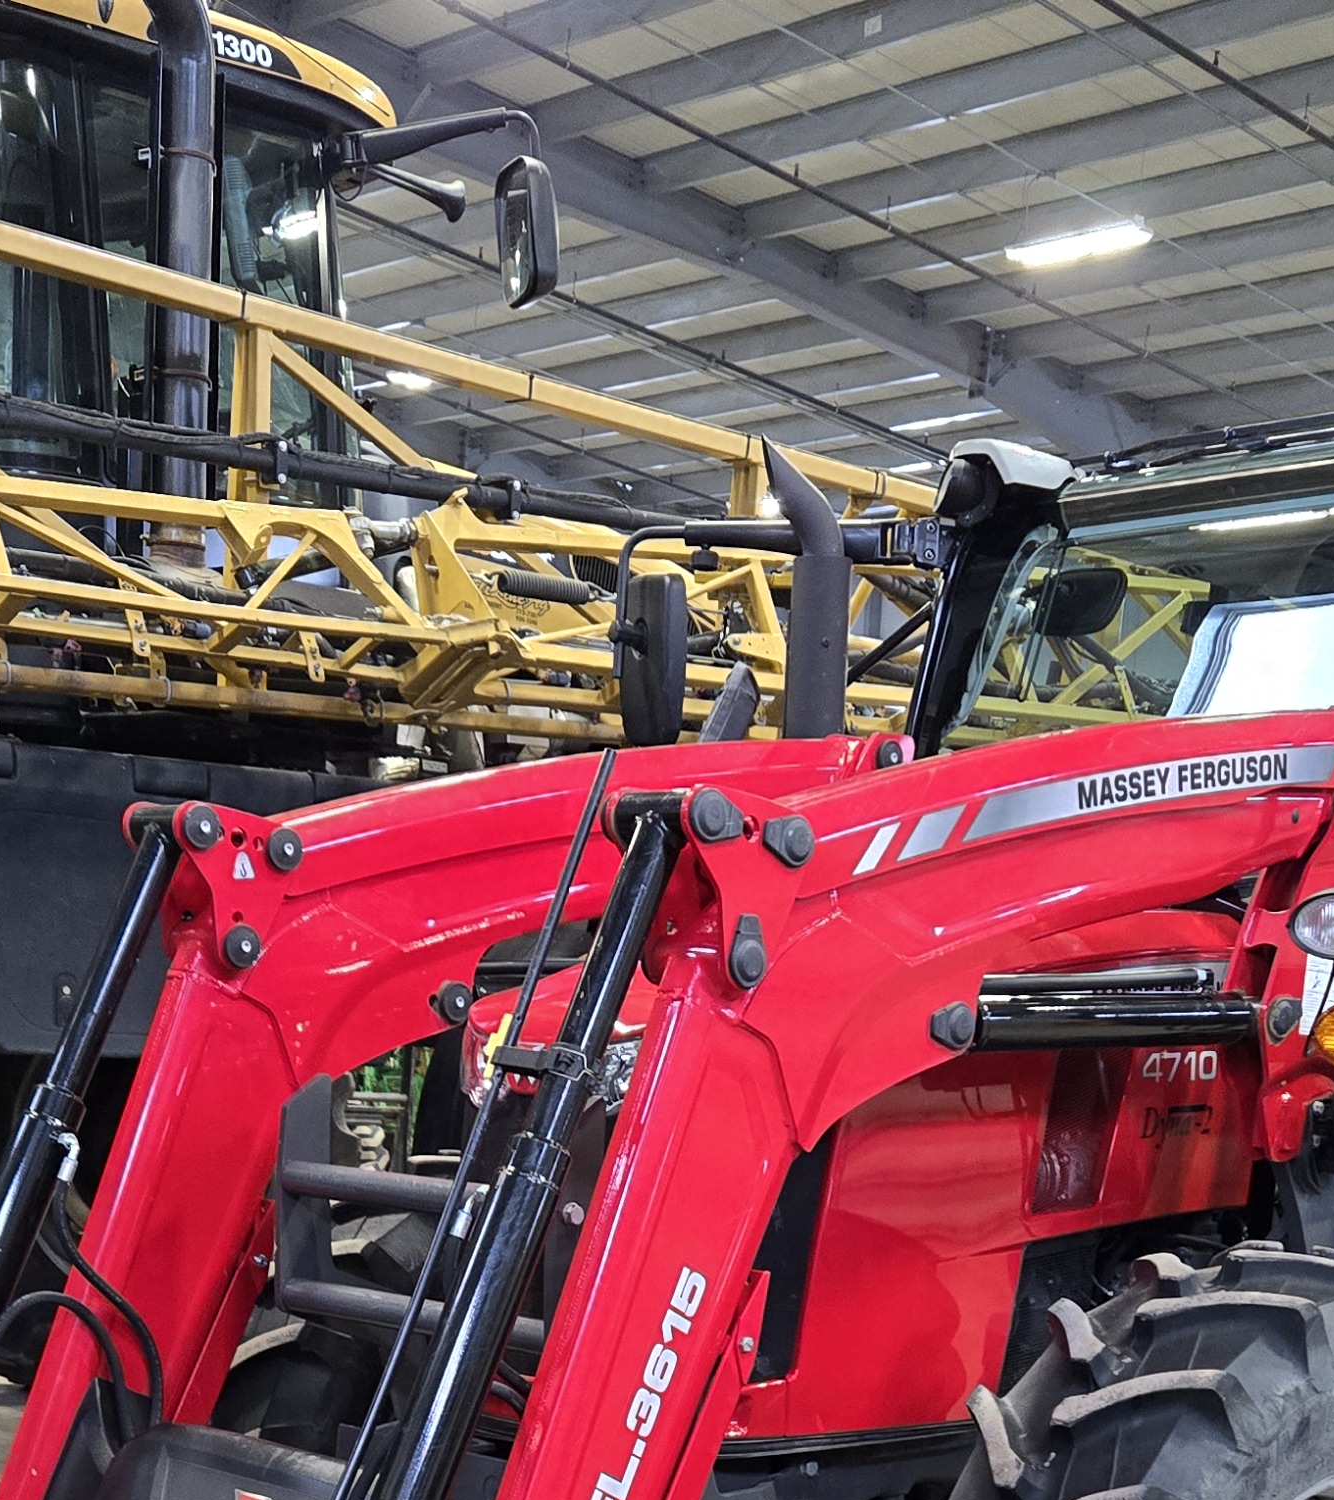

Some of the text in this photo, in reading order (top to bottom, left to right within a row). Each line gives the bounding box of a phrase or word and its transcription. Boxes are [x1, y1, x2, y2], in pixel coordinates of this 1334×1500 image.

[212, 30, 273, 68] 1300
[1077, 752, 1289, 810] MASSEY FERGUSON
[1142, 1049, 1218, 1083] 4710
